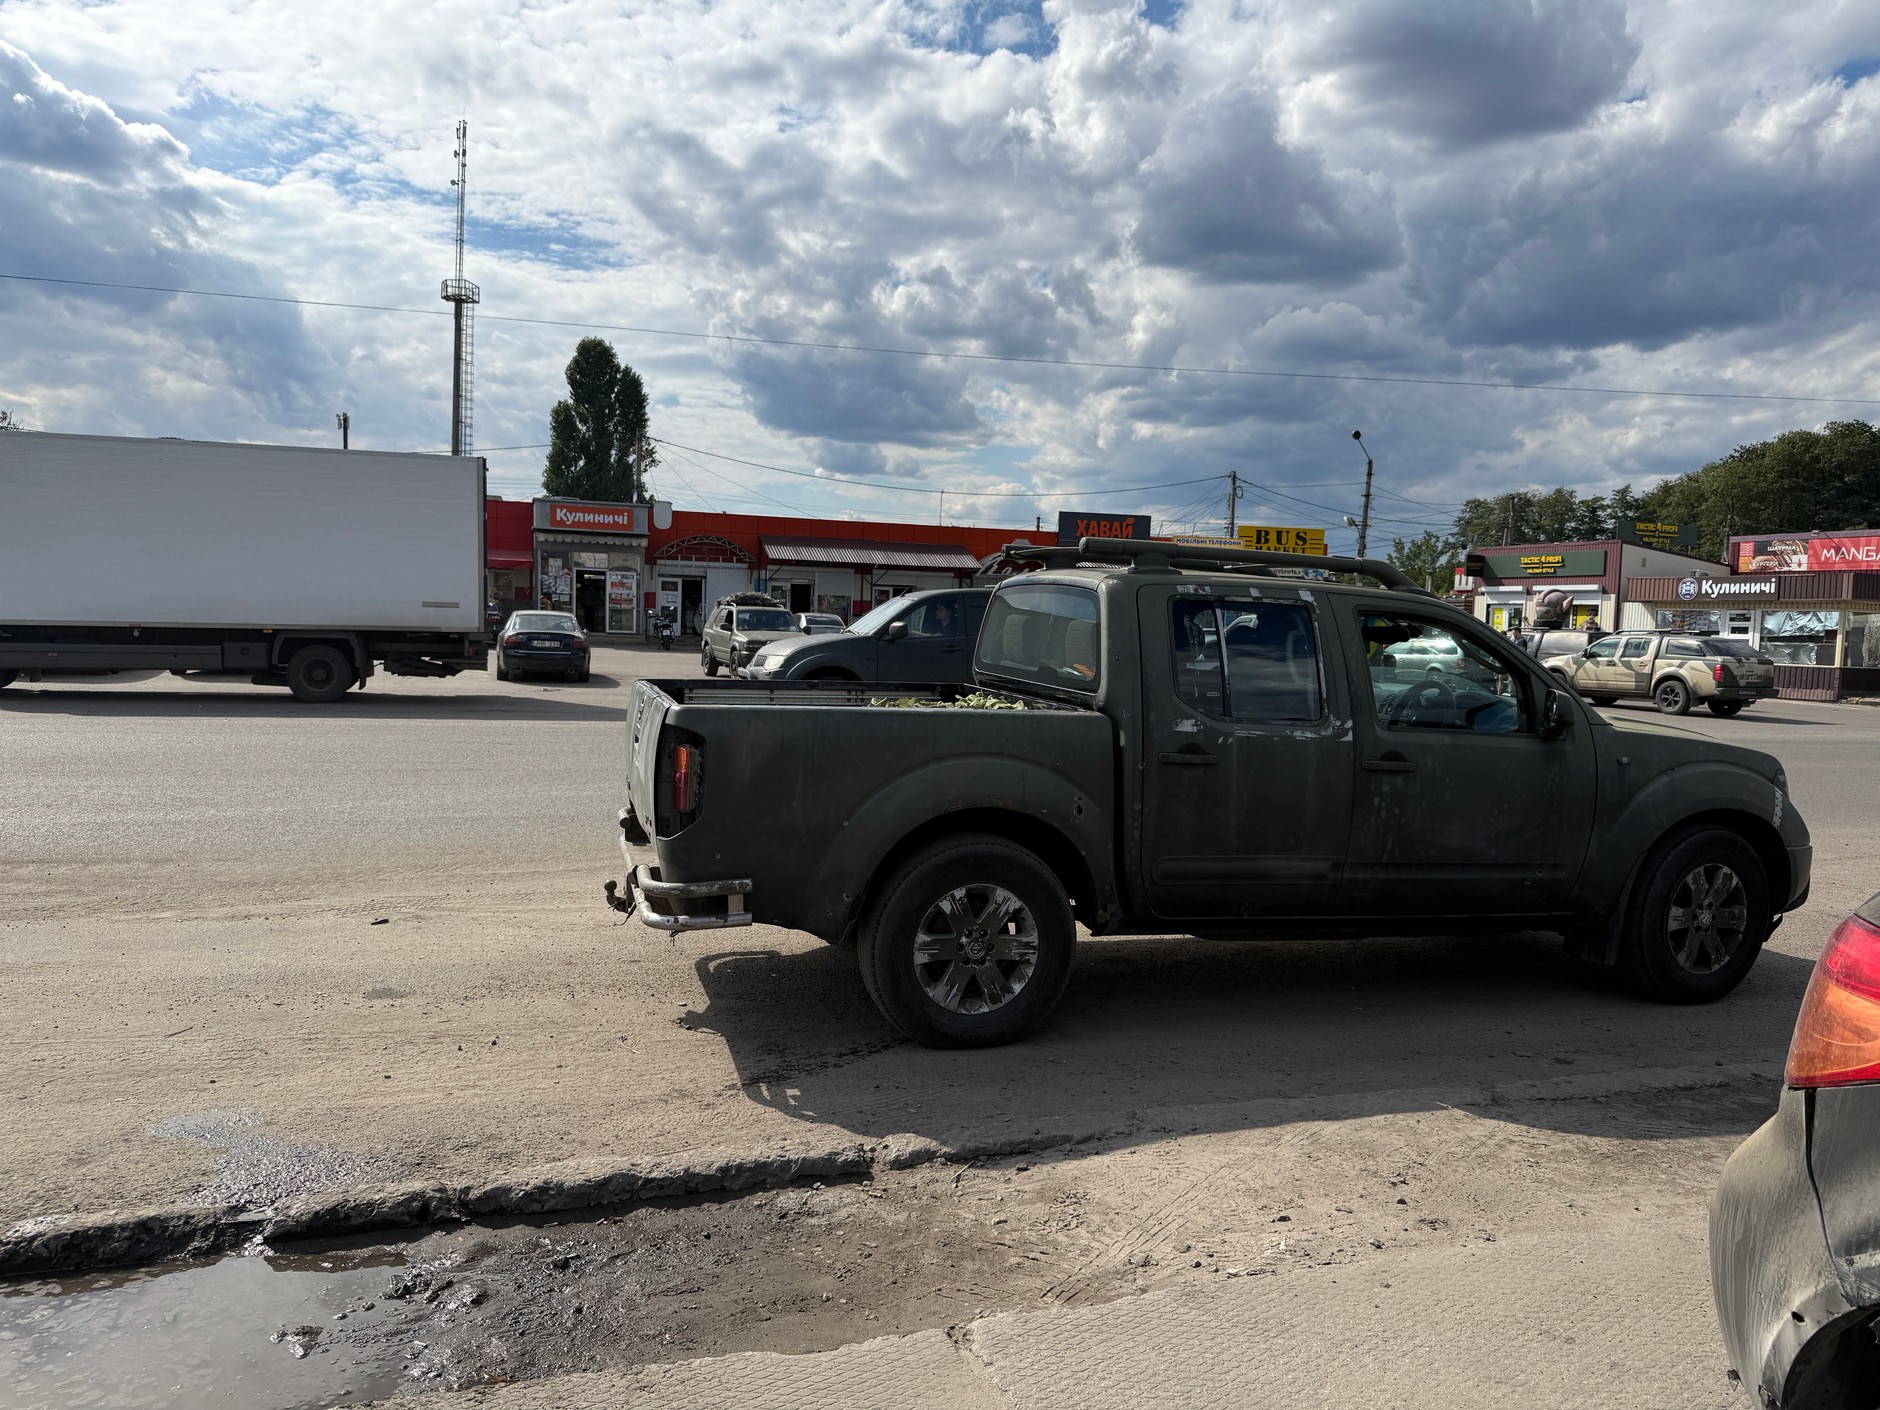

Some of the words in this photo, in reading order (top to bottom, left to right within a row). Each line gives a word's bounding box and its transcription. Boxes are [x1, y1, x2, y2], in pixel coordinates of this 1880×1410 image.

[556, 508, 628, 525] Кулиничі
[1075, 517, 1135, 539] ХАВАЙ
[1635, 522, 1656, 531] TACTIC
[1662, 524, 1679, 533] PROFI
[1176, 538, 1207, 546] МОБІЛЬНІ
[1255, 529, 1309, 546] BUS
[1255, 545, 1308, 555] MARKET
[1821, 546, 1880, 561] MANG
[1520, 556, 1540, 564] TACTIC
[1546, 555, 1562, 563] PROFI
[1701, 577, 1776, 598] Кулиничі
